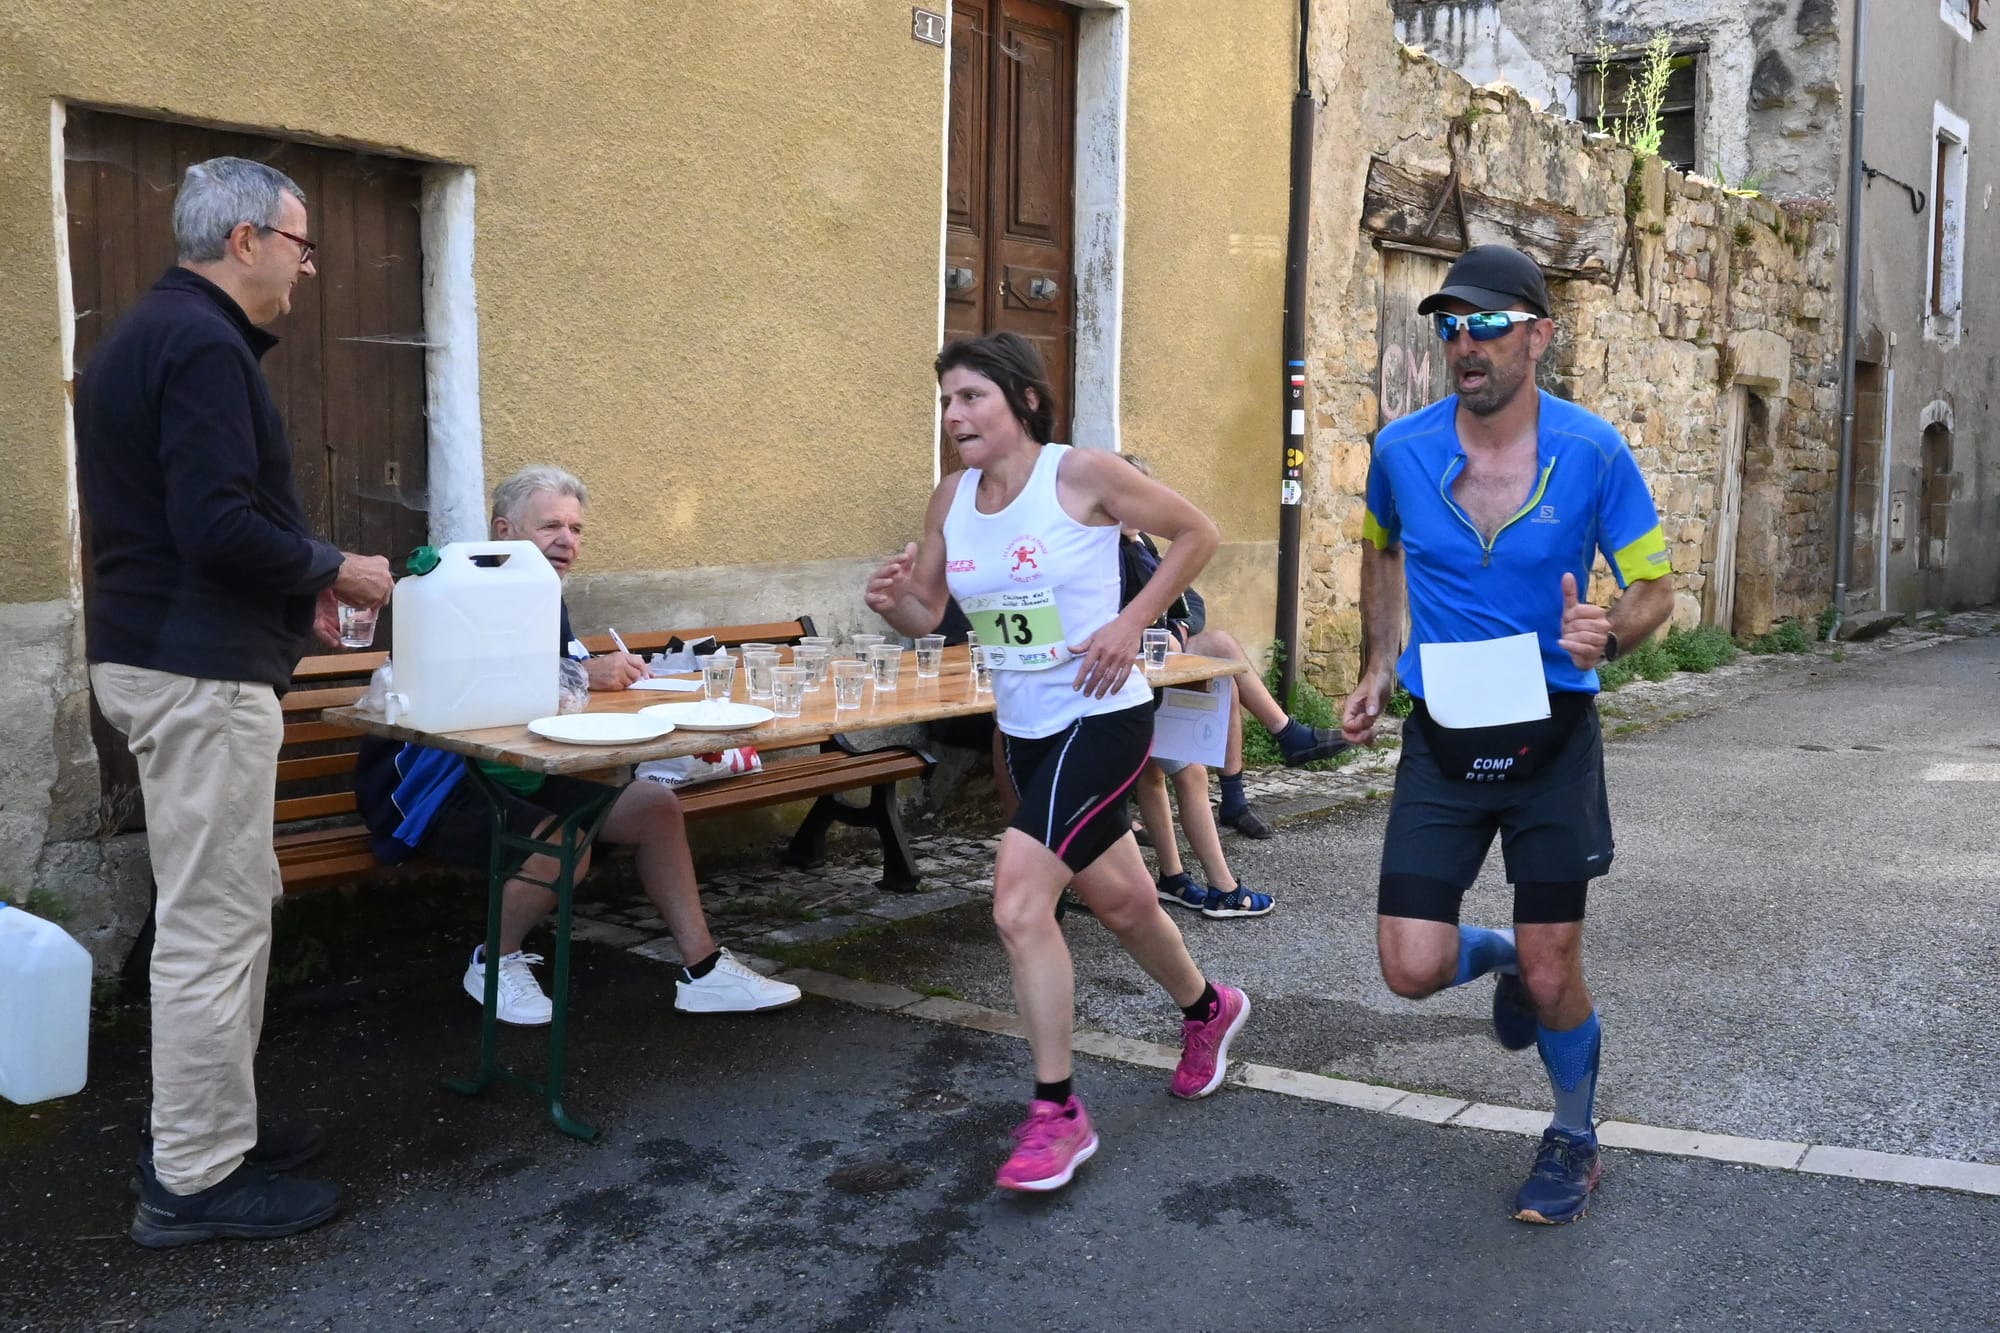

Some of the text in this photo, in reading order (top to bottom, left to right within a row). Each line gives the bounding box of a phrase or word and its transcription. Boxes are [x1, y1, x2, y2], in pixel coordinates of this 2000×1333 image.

[926, 17, 934, 38] 1
[995, 613, 1033, 645] 13
[1472, 757, 1514, 770] COMP
